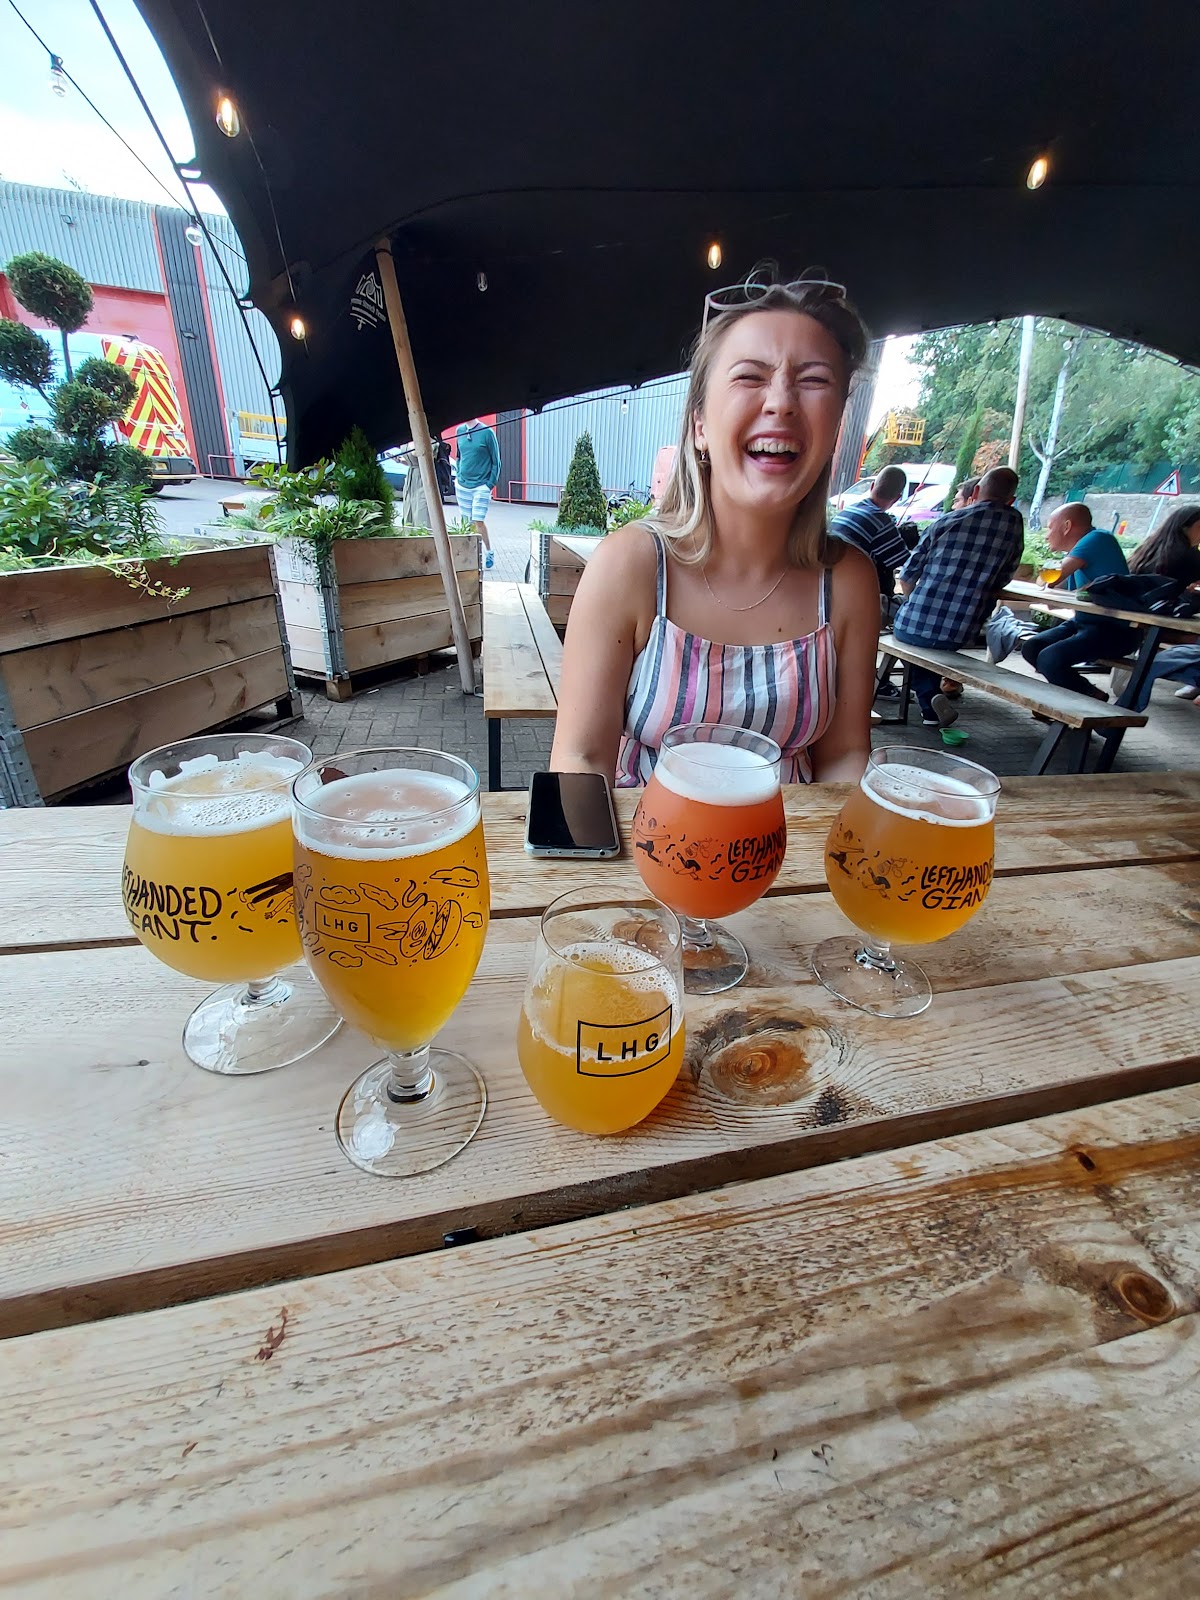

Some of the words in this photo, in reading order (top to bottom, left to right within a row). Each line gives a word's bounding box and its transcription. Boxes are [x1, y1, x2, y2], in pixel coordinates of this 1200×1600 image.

[731, 852, 783, 883] GIAN
[921, 857, 993, 895] LEFTHANDE
[922, 885, 989, 910] GIAN
[124, 905, 218, 943] IANT.
[323, 914, 359, 933] LHG
[597, 1032, 659, 1061] LHG
